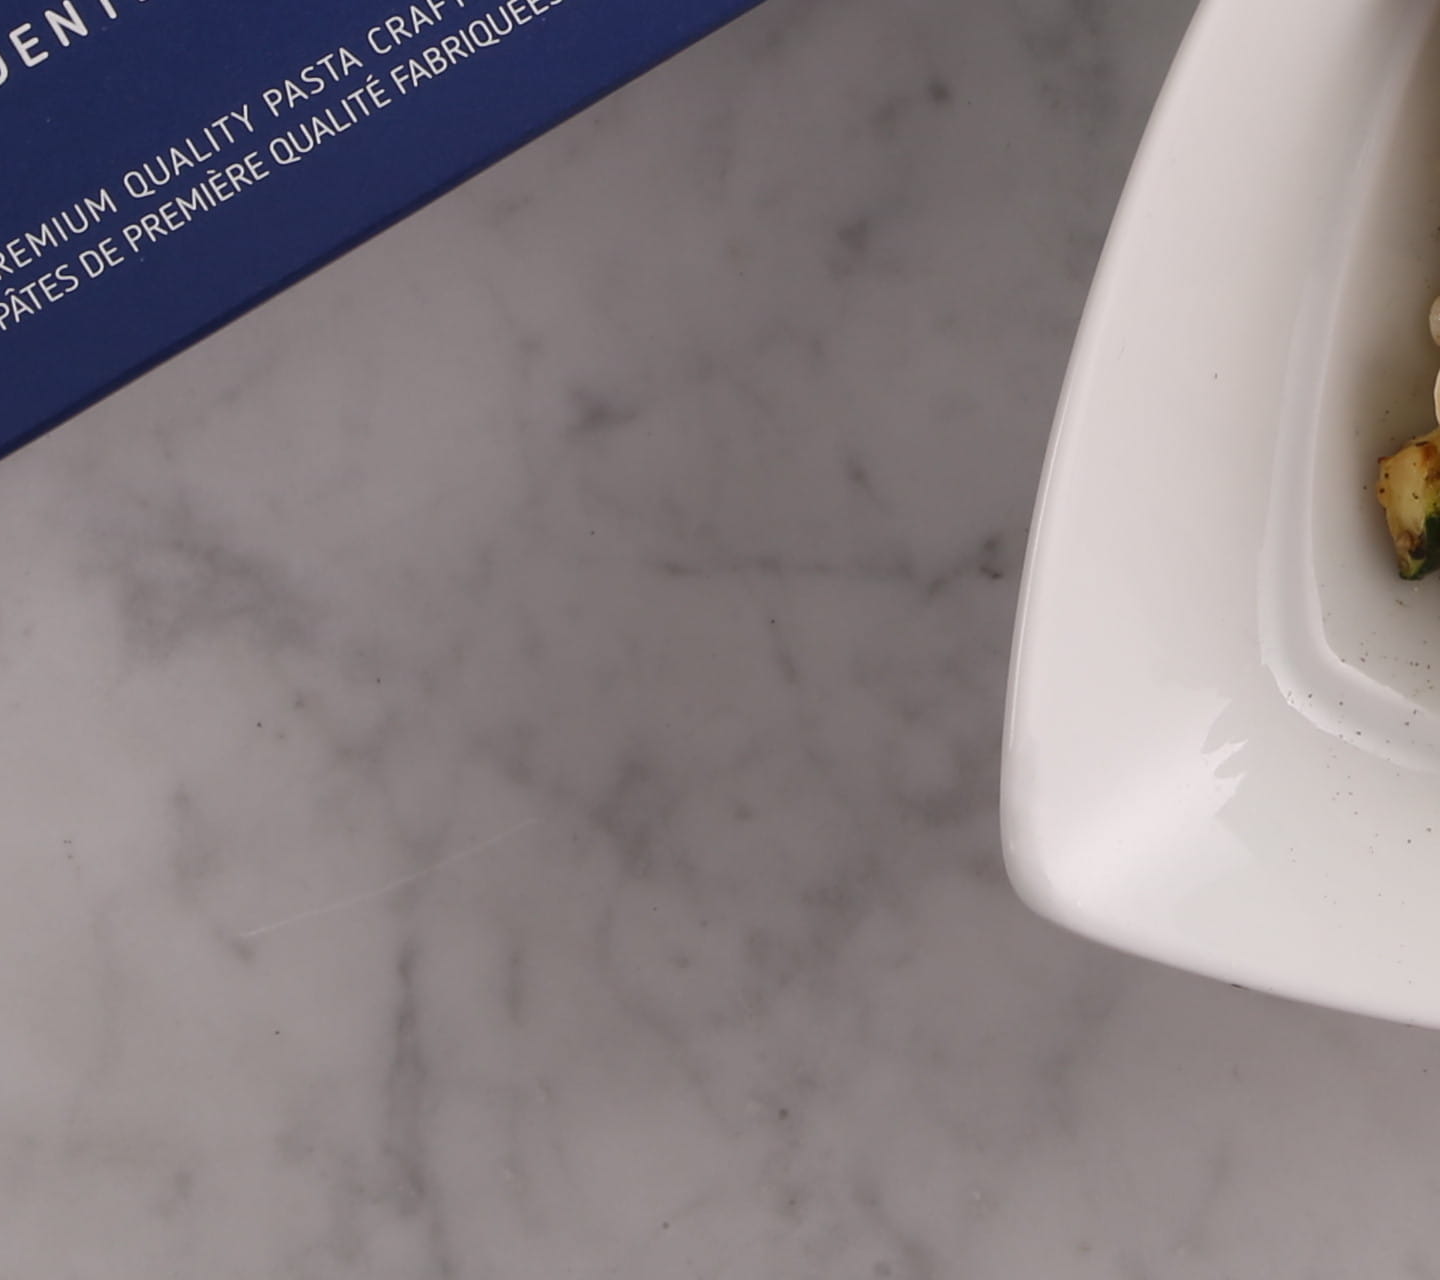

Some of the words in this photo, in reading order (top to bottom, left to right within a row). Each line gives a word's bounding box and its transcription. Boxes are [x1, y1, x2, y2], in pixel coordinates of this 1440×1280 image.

[79, 238, 124, 278] DE
[123, 152, 269, 252] PREMIÈRE
[270, 75, 391, 164] QUALITÉ
[124, 105, 253, 197] QUALITY
[263, 48, 363, 116] PASTA
